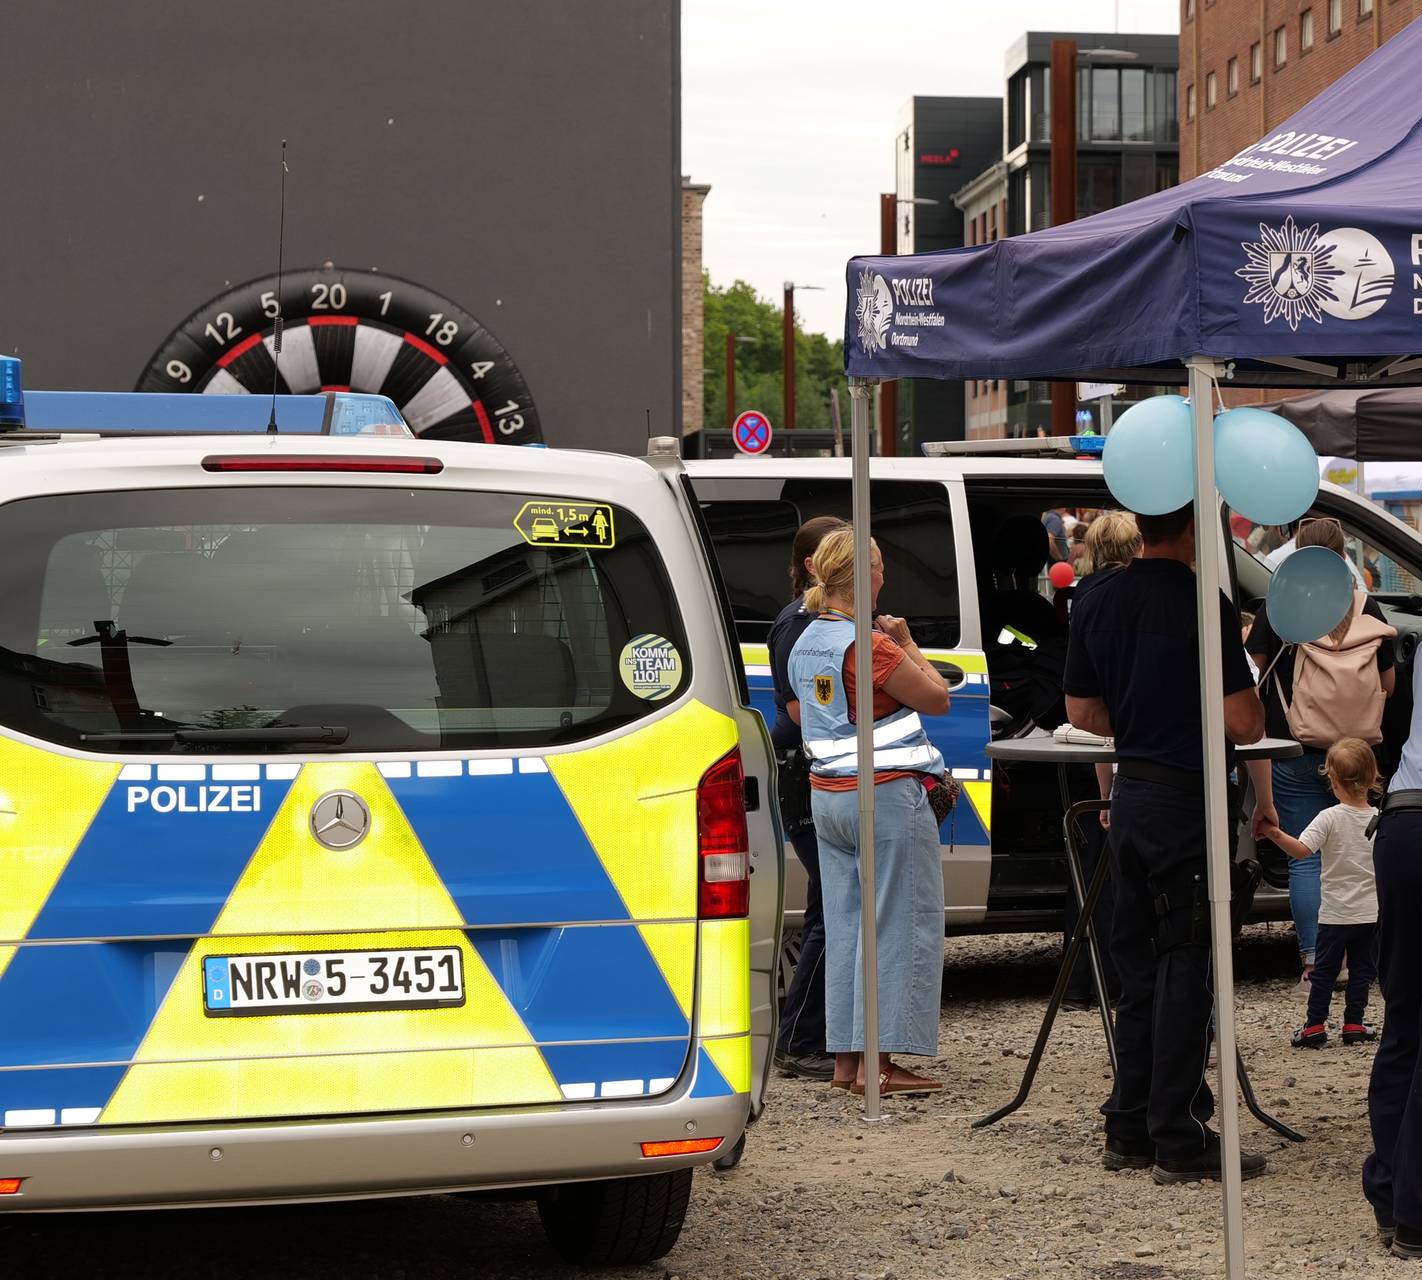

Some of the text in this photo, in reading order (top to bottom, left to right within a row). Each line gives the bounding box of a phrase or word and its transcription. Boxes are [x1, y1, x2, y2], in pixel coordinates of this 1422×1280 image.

[311, 283, 347, 311] 20
[380, 291, 393, 316] 1
[891, 278, 934, 306] POLIZEI
[261, 291, 280, 319] 5
[205, 311, 243, 347] 12
[423, 312, 459, 346] 18
[894, 312, 945, 327] Nordrhein-Westfalen
[891, 332, 919, 347] Dortmund
[166, 359, 193, 383] 9
[471, 358, 495, 380] 4
[494, 399, 525, 435] 13
[530, 506, 589, 523] mind. 1,5 m
[632, 647, 668, 658] KOMM
[637, 658, 675, 670] TEAM
[633, 670, 659, 683] 110!
[127, 786, 261, 813] POLIZEI
[213, 954, 459, 1002] D NRW 5-3451
